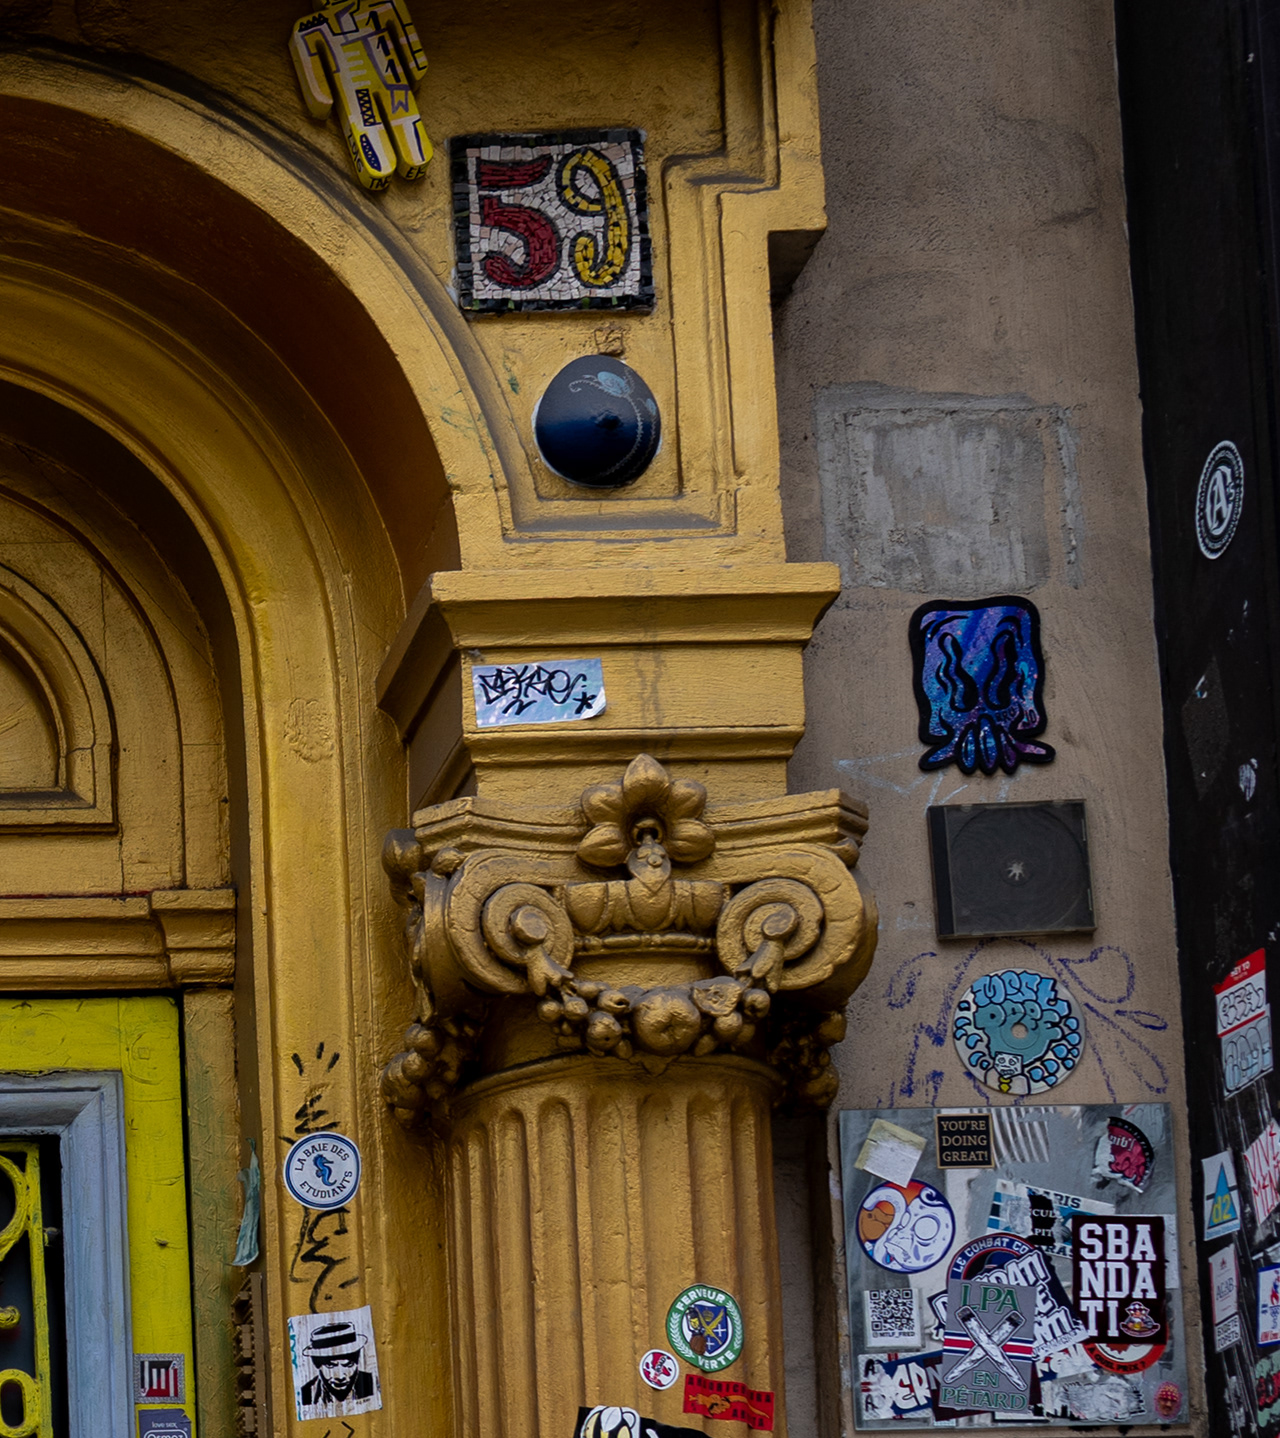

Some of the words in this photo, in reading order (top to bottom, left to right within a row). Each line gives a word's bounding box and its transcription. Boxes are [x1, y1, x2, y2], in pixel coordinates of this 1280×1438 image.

[476, 148, 630, 288] 59
[941, 1120, 987, 1132] YOU'RE
[941, 1135, 987, 1147] DOING
[942, 1150, 989, 1163] GREAT!
[1079, 1223, 1157, 1262] SBA
[1079, 1261, 1157, 1299] NDA
[675, 1287, 727, 1313] FERVEUR
[960, 1283, 1020, 1313] LPA
[1079, 1299, 1119, 1337] TI
[696, 1346, 738, 1370] VERTE
[972, 1370, 1000, 1388] EN
[940, 1383, 1027, 1411] PÊTARD
